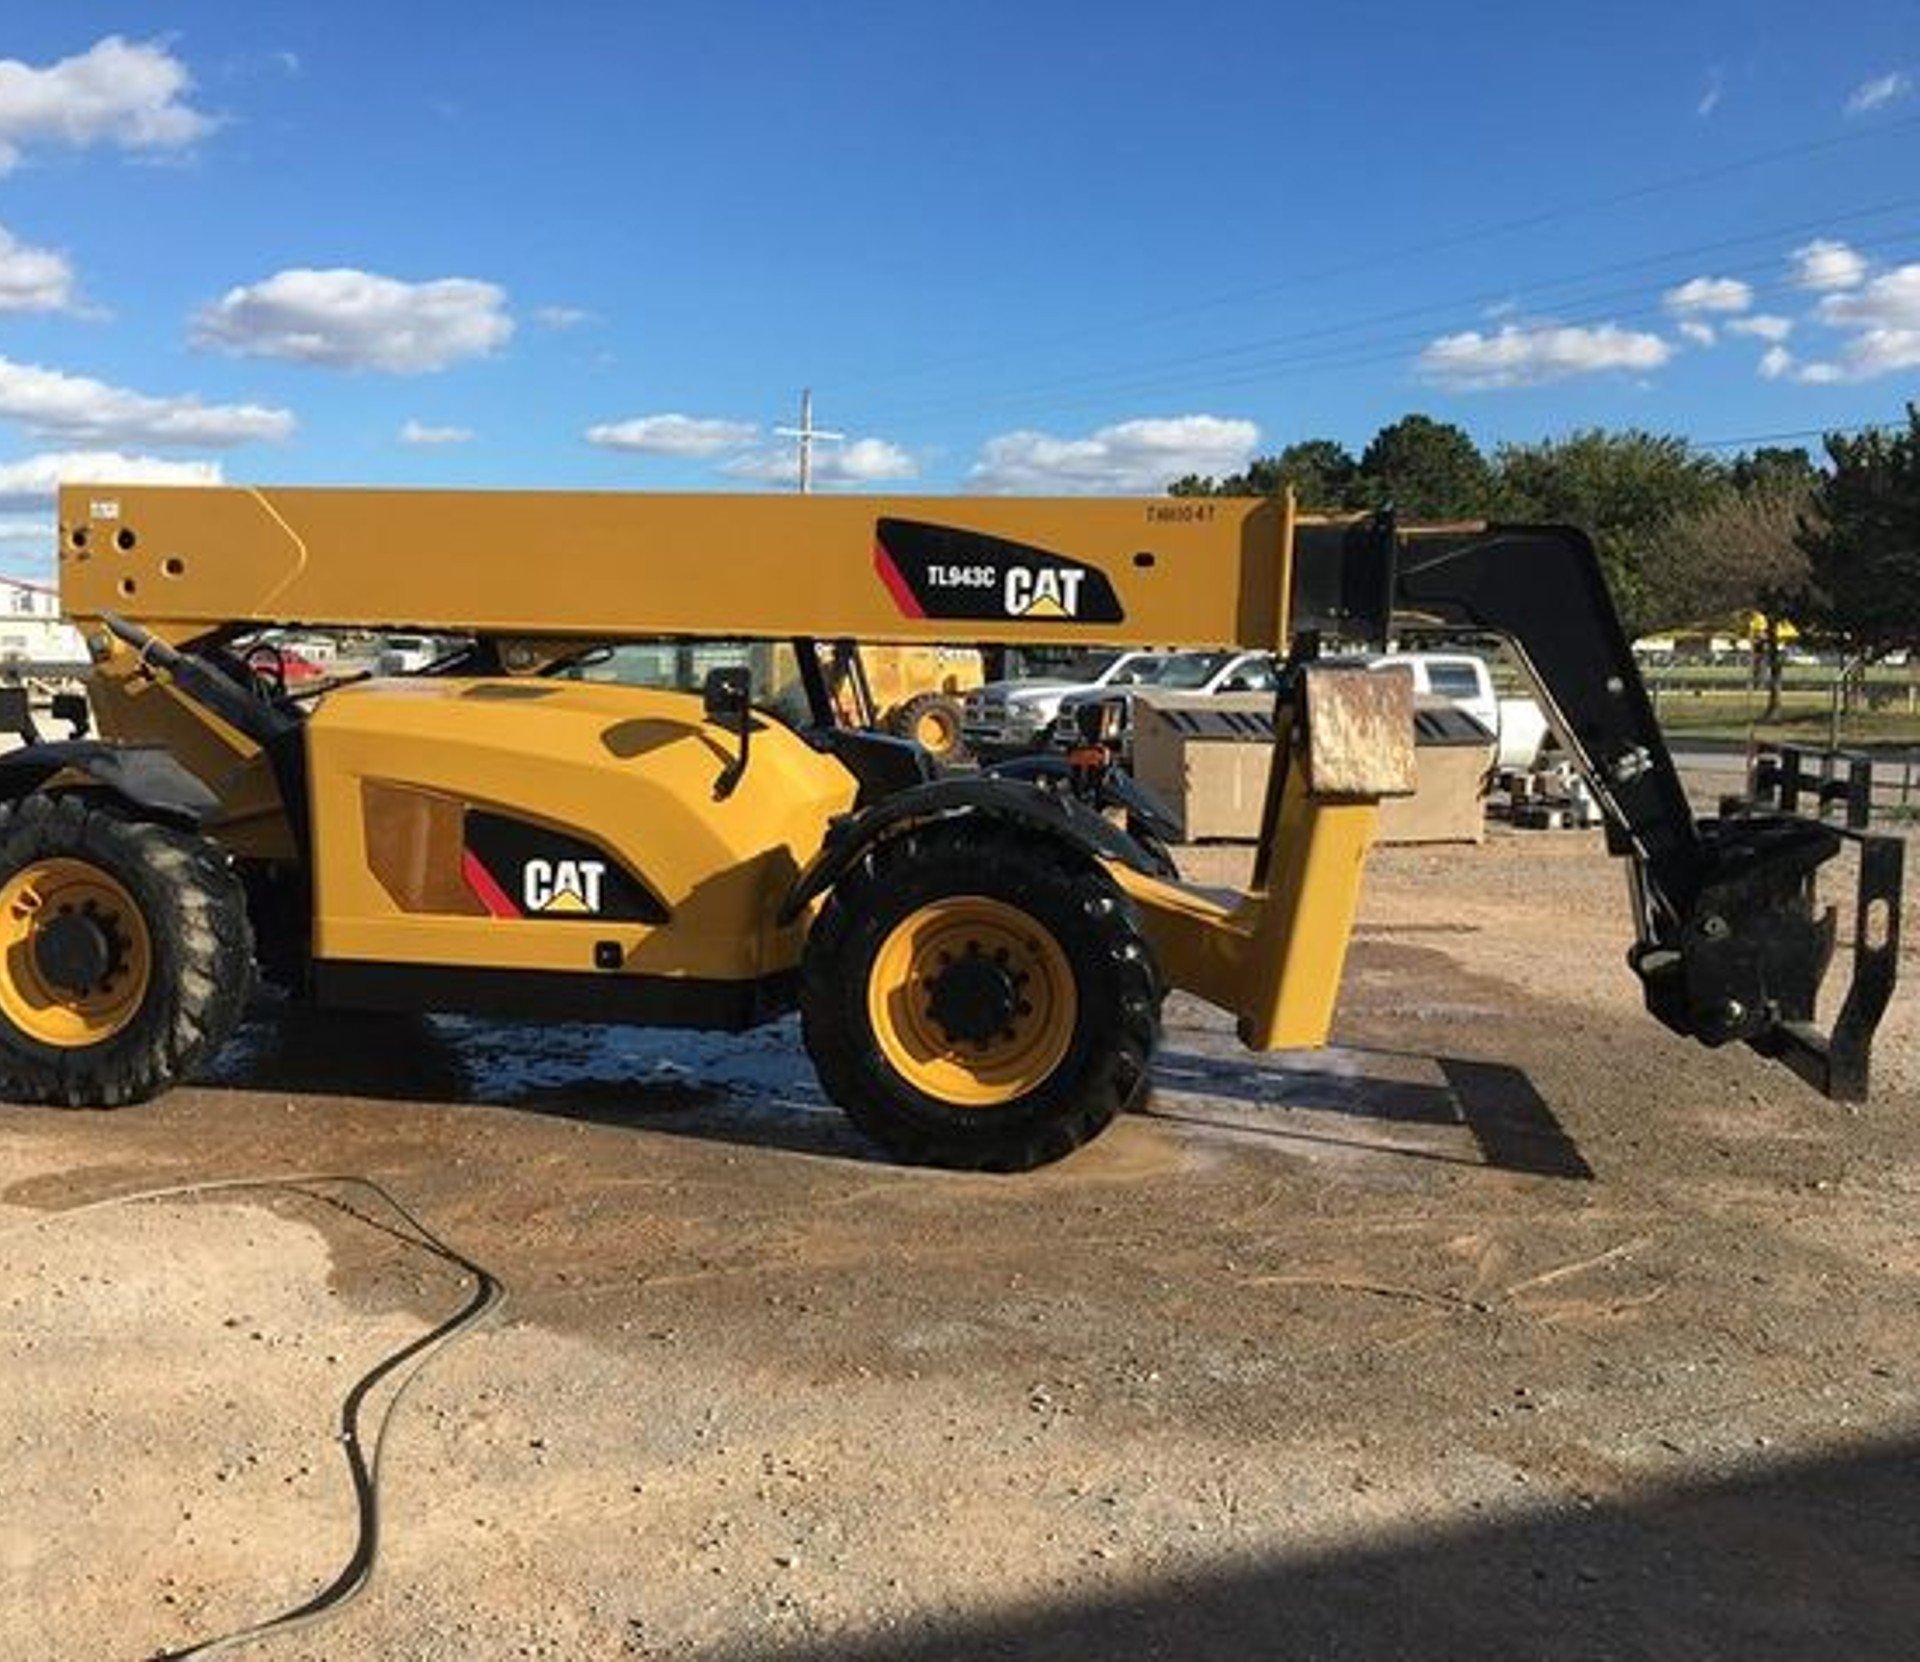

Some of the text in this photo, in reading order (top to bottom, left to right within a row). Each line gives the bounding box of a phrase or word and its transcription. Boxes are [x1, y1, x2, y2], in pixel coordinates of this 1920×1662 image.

[928, 566, 1085, 616] TL943C CAT
[524, 858, 606, 913] CAT
